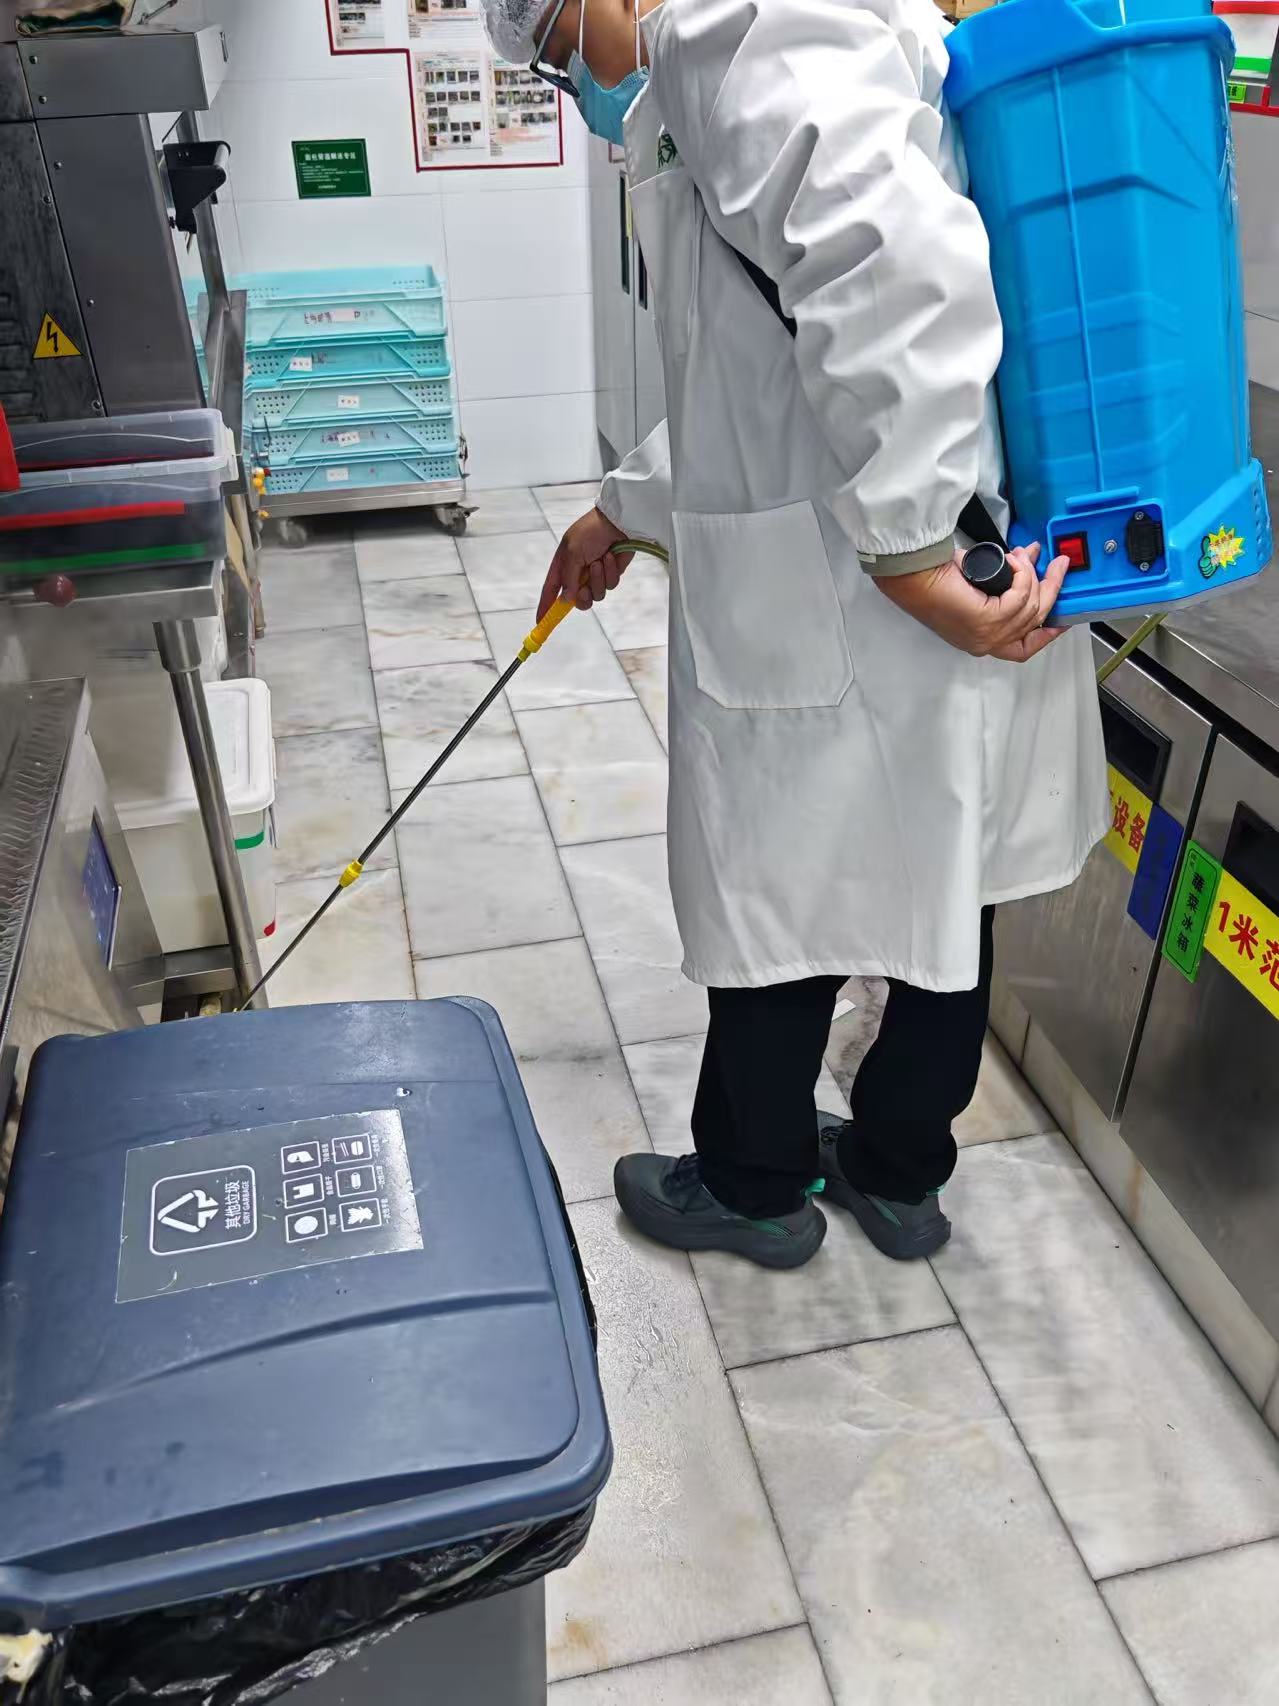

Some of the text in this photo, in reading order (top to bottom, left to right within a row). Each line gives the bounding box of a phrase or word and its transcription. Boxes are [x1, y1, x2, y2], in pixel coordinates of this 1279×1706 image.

[1109, 790, 1145, 854] 设备
[1177, 871, 1205, 953] 蔬菜冰箱
[224, 1180, 241, 1230] 其他垃圾
[241, 1180, 251, 1225] DRY GARBAGE
